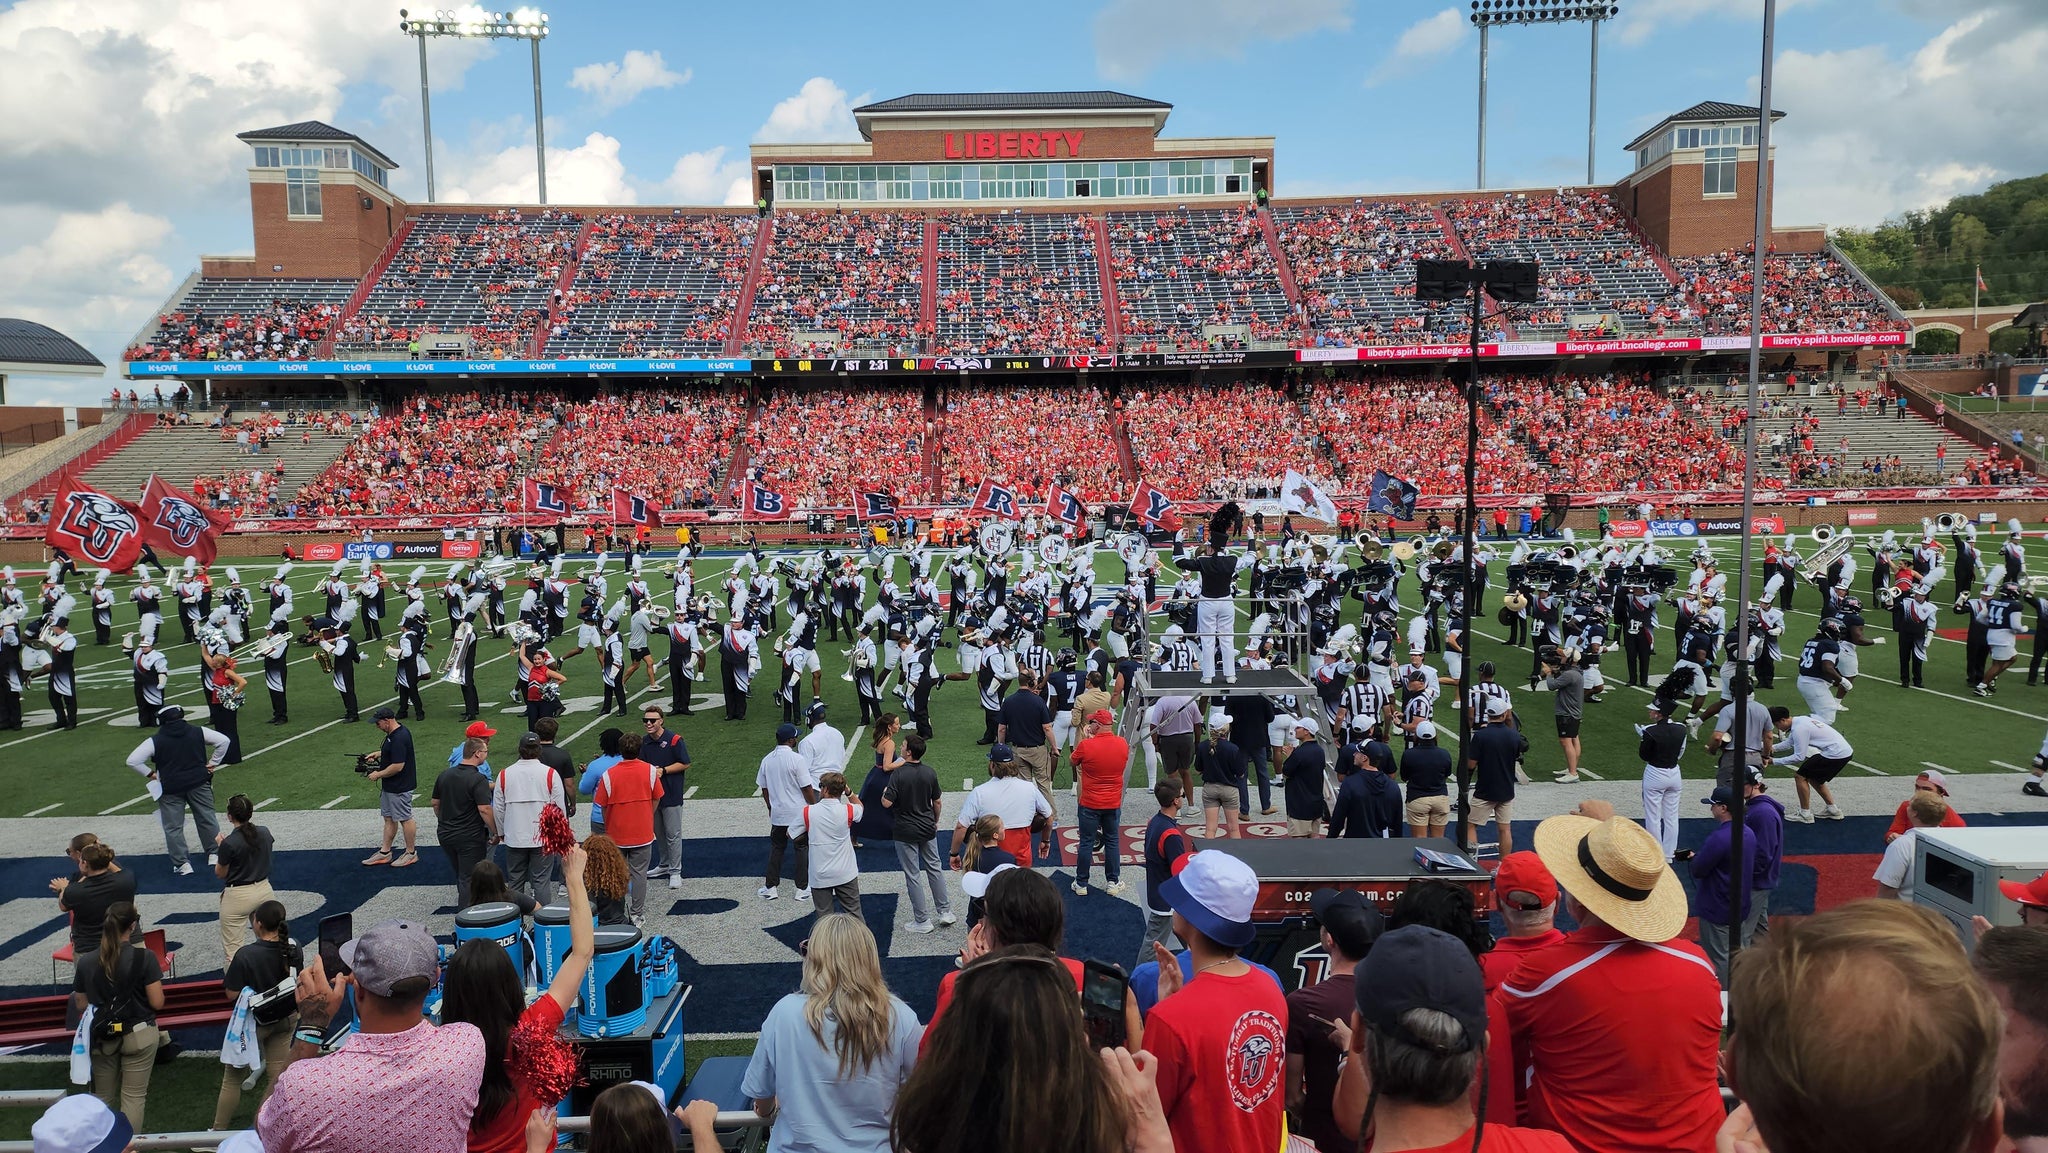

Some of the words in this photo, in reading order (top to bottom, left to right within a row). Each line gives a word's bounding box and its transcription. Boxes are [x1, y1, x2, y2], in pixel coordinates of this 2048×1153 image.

[945, 131, 1084, 158] LIBERTY
[1566, 340, 1689, 352] liberty.spirit.bncollege.com
[1773, 334, 1899, 347] liberty.spirit.bncollege.com
[1367, 346, 1485, 358] liberty.spirit.bncollege.cm
[844, 360, 860, 371] 1ST
[869, 360, 888, 370] 2:31
[536, 482, 566, 514] L
[753, 487, 782, 516] B
[864, 493, 896, 516] E
[986, 486, 1014, 515] R
[1146, 489, 1172, 521] Y
[630, 495, 648, 525] I
[1058, 494, 1083, 523] T
[1651, 520, 1680, 529] Carter
[1651, 528, 1676, 537] Bank
[1708, 522, 1740, 530] Autova
[347, 543, 377, 552] Carter
[347, 551, 371, 560] Bank
[404, 546, 436, 554] Autova
[1030, 654, 1040, 669] U
[1178, 652, 1188, 667] R
[1800, 648, 1814, 668] 56
[1066, 682, 1078, 703] 7
[1361, 695, 1376, 712] H
[1259, 826, 1276, 835] 2
[545, 930, 553, 984] POWERADE
[588, 958, 597, 1016] POWERADE
[1249, 1018, 1280, 1054] TRADITIONS
[657, 1034, 681, 1081] POWERADE
[590, 1068, 632, 1080] RHINO
